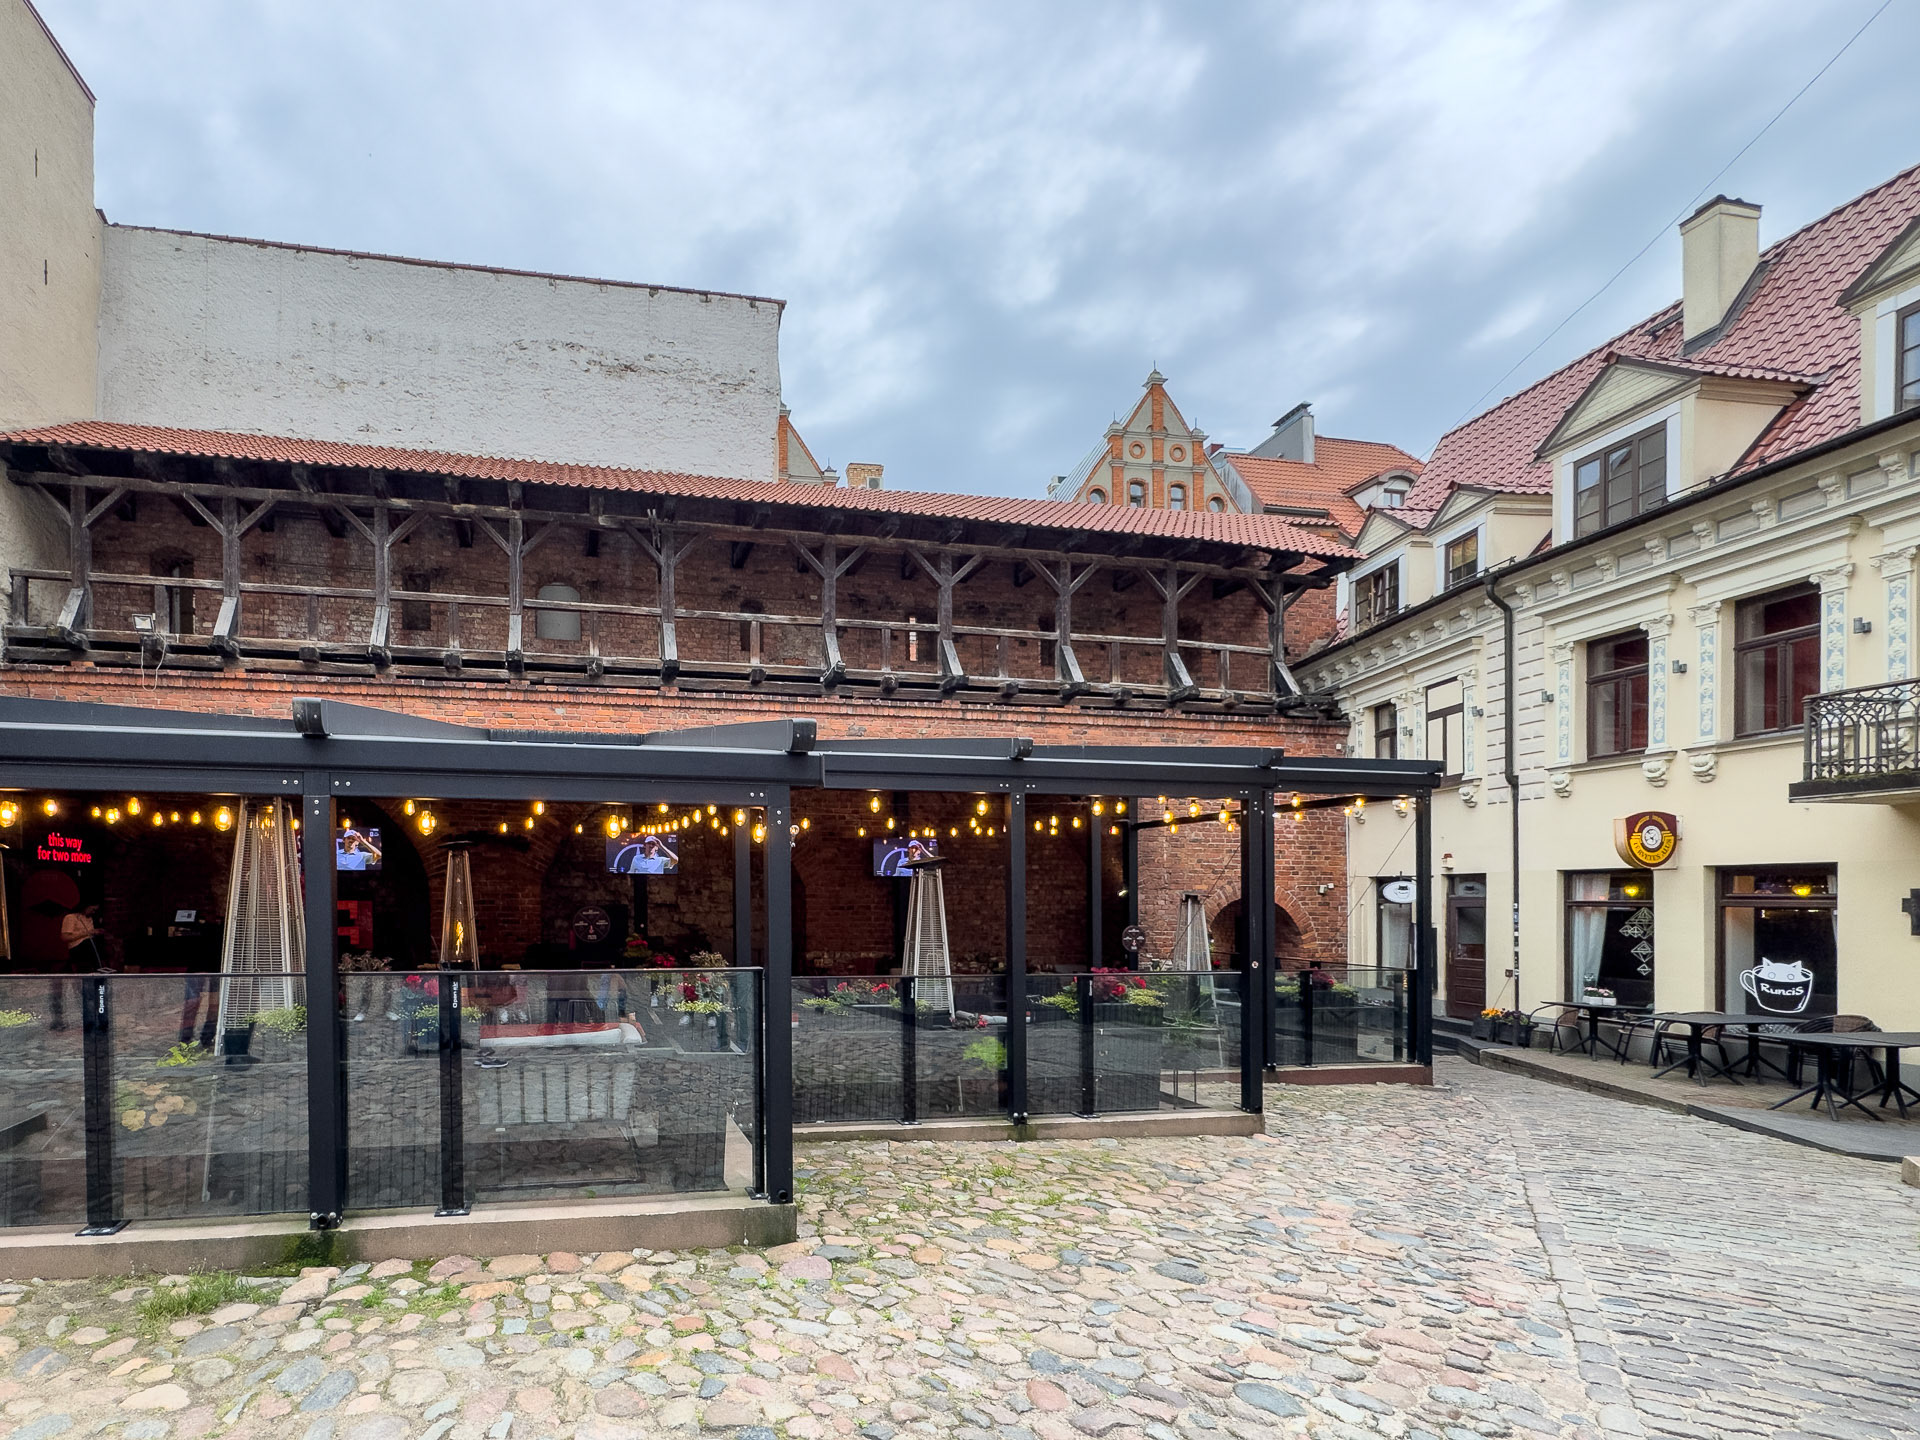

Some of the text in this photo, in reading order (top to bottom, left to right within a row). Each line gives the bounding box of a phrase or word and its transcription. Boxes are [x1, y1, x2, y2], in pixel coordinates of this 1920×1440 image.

[48, 832, 82, 851] this way
[37, 845, 92, 863] for two more
